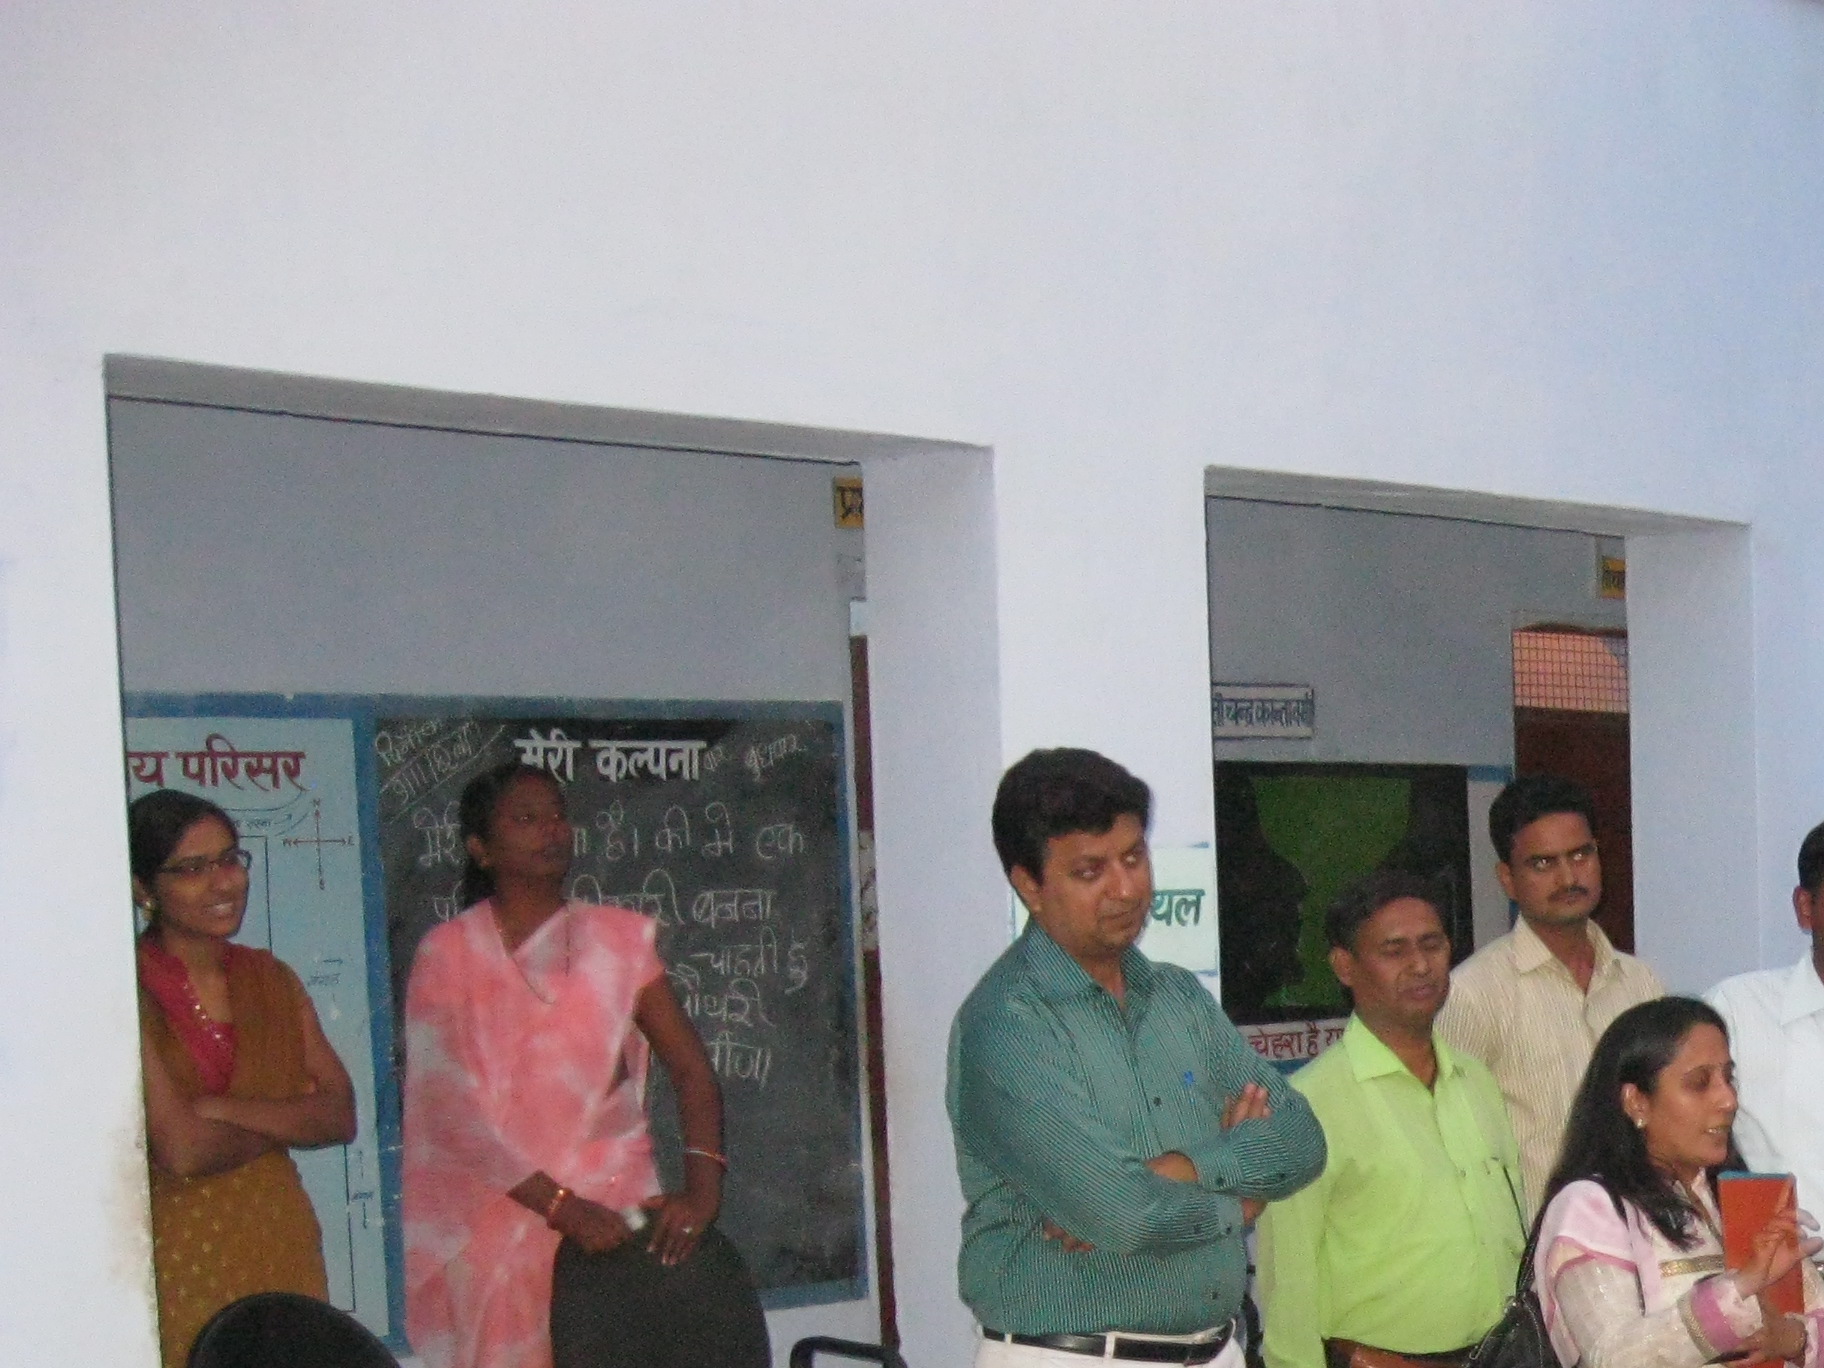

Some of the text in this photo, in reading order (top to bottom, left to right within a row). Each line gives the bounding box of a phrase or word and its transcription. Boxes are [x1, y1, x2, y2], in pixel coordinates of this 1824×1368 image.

[126, 733, 308, 791] य परिसर
[588, 739, 708, 783] कल्पना
